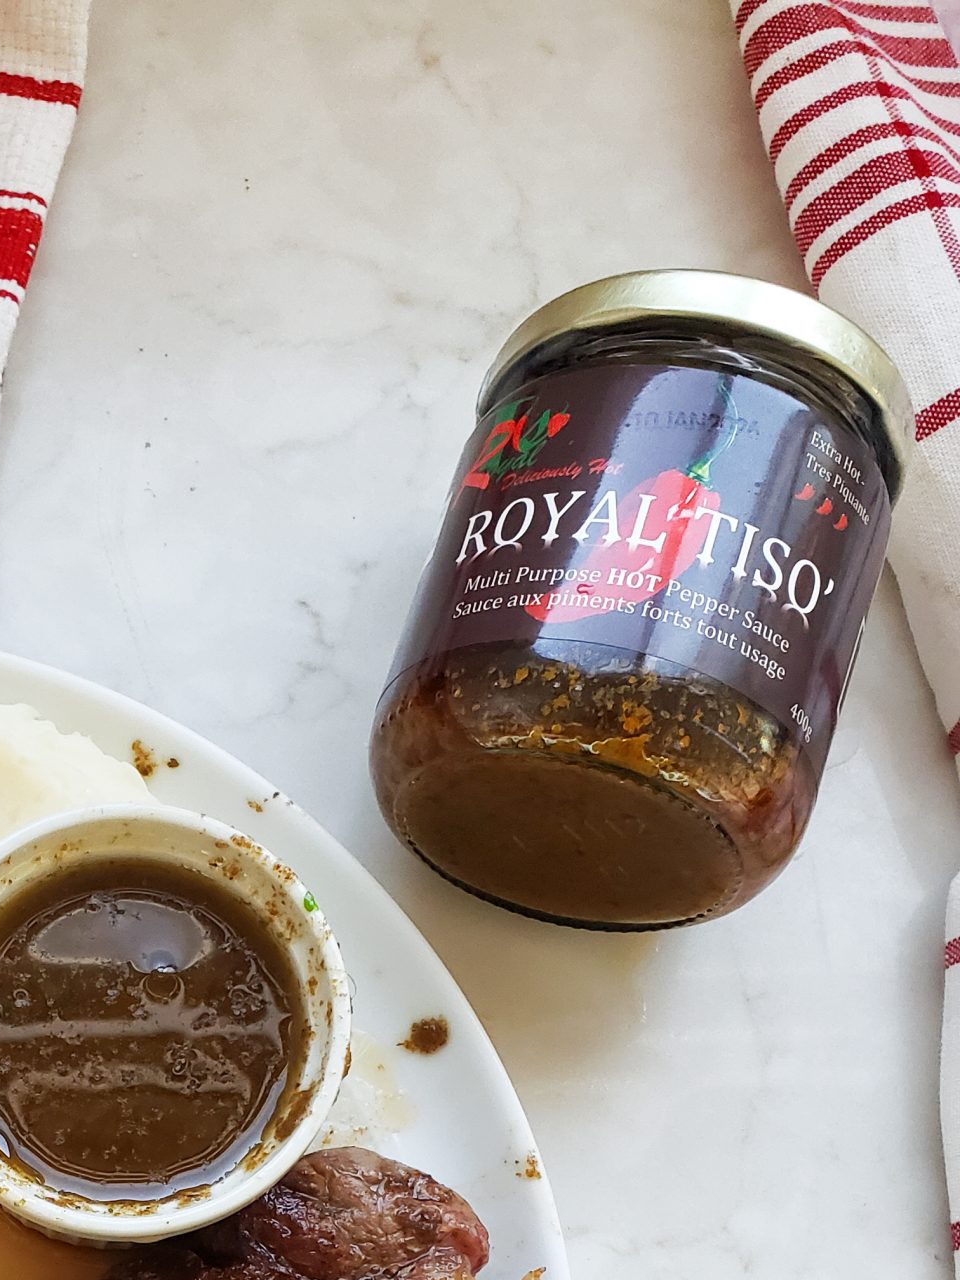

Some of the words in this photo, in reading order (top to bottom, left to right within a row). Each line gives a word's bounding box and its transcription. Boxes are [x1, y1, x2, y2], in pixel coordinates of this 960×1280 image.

[501, 461, 582, 491] Deliciously
[588, 457, 624, 476] Hot
[810, 431, 843, 464] Extra
[806, 452, 833, 482] Tres
[833, 473, 870, 526] Piquante
[455, 490, 667, 566] ROYAL
[452, 597, 502, 619] Sauce
[506, 593, 544, 607] aux
[547, 589, 635, 614] piments
[641, 600, 692, 630] forts
[697, 619, 738, 650] tout
[740, 640, 787, 681] usage
[464, 568, 512, 595] Multi
[515, 566, 601, 585] Purpose
[606, 567, 663, 593] HOT
[666, 579, 740, 621] Pepper
[742, 610, 790, 653] Sauce
[790, 702, 813, 744] 400g
